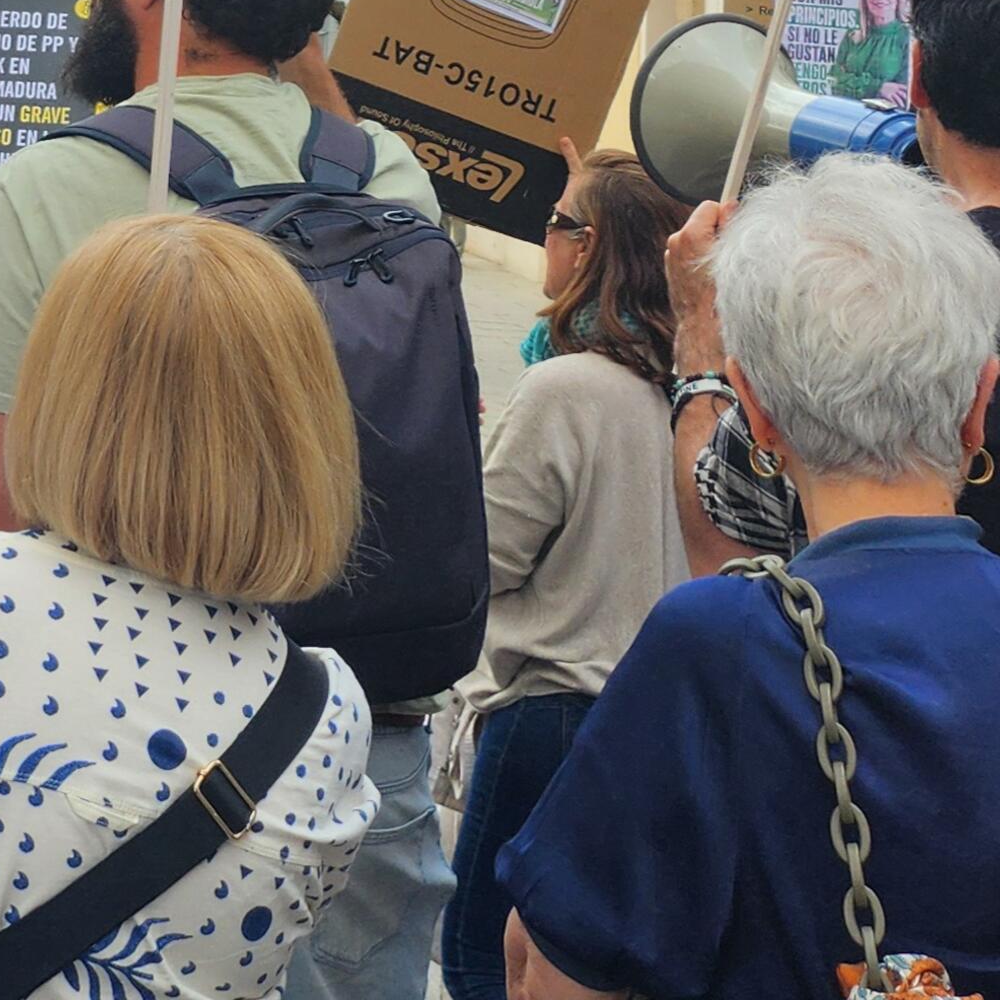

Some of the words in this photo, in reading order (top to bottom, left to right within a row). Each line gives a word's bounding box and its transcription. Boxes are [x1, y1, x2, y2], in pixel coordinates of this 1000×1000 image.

[47, 12, 68, 30] DE
[16, 34, 37, 52] DE
[42, 36, 64, 53] PP
[68, 36, 79, 53] Y
[787, 26, 800, 42] SI
[803, 28, 820, 45] NO
[824, 30, 839, 46] LE
[787, 43, 836, 63] GUSTAN
[9, 57, 30, 75] EN
[794, 62, 828, 81] ENGO
[19, 106, 71, 125] GRAVE
[16, 128, 38, 147] EN
